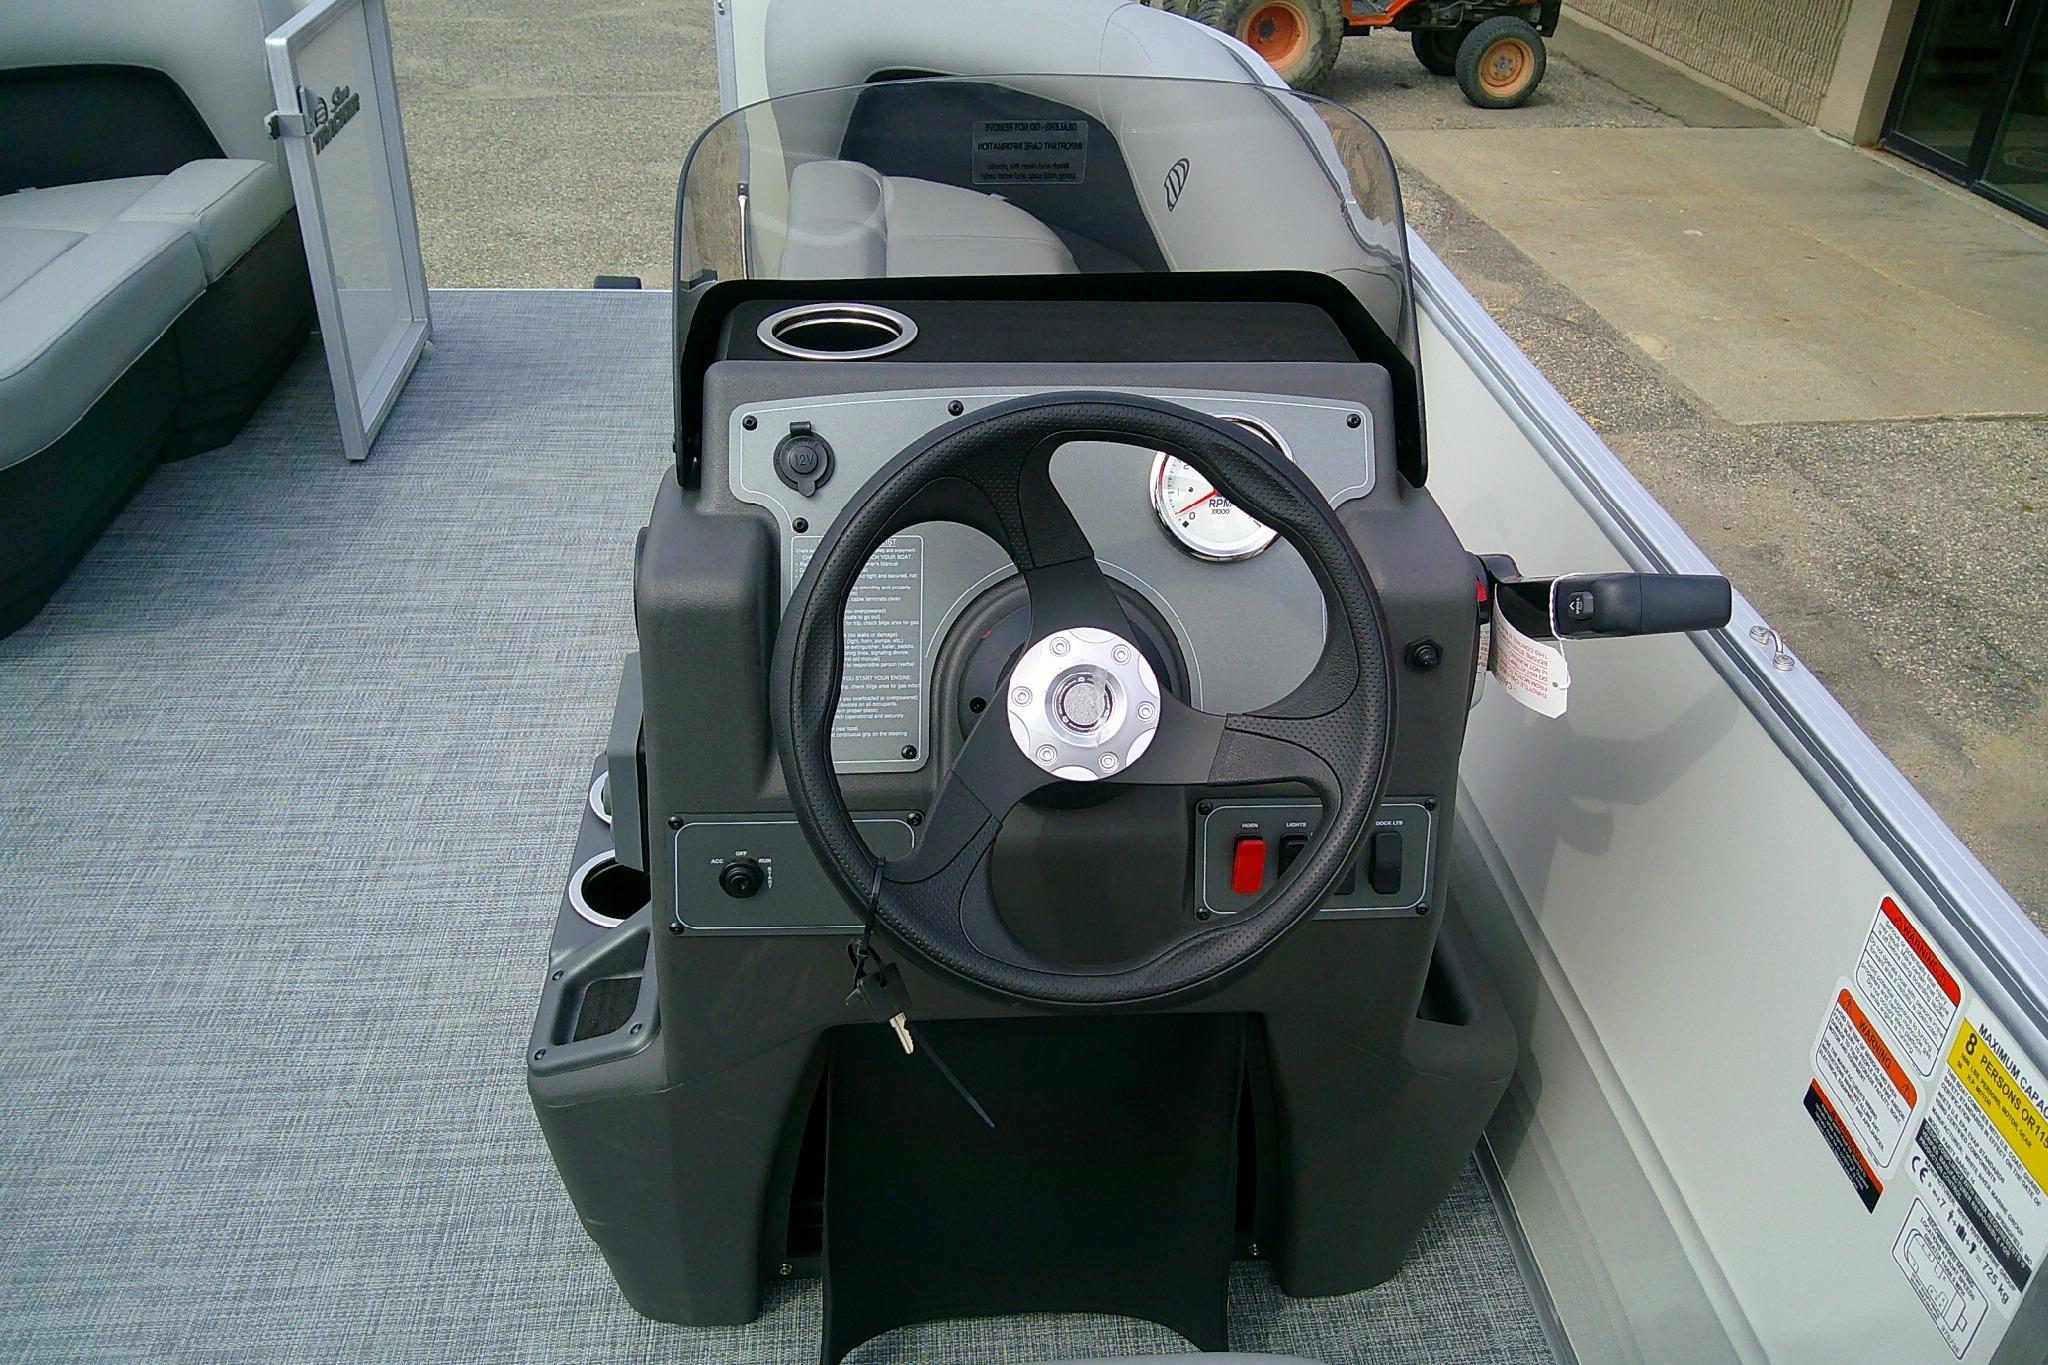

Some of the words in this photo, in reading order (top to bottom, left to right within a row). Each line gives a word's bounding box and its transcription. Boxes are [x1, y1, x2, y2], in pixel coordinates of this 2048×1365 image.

[795, 454, 814, 467] 12V
[1188, 511, 1196, 520] 0
[1903, 926, 1937, 972] WARNING
[1859, 1020, 1890, 1068] WARNING
[1979, 1024, 2019, 1078] MAXIMUM
[1941, 1082, 1970, 1122] CERTIFICATION
[1965, 1032, 1977, 1055] 8
[1980, 1055, 2020, 1109] PERSONS
[2021, 1108, 2034, 1130] OR
[1975, 1085, 1991, 1106] MOTOR
[1937, 1091, 1951, 1109] MEETS
[1950, 1108, 1958, 1121] U.S.
[1958, 1119, 1967, 1133] EPA
[1967, 1131, 1979, 1147] EVAP
[1979, 1147, 2004, 1182] STANDARDS
[1941, 1137, 1955, 1156] PARTY
[1943, 1075, 1959, 1095] SAFETY
[1959, 1095, 1983, 1130] STANDARDS
[1983, 1129, 1989, 1137] IN
[1988, 1135, 2005, 1158] EFFECT
[2005, 1158, 2012, 1169] ON
[2012, 1167, 2022, 1181] THE
[2021, 1179, 2033, 1198] DATE
[2033, 1196, 2041, 1206] OF
[1946, 1068, 1956, 1082] THIS
[1955, 1080, 1967, 1096] BOAT
[1967, 1096, 1988, 1125] COMPLIES
[1988, 1124, 2000, 1140] WITH
[1999, 1138, 2007, 1153] U.S.
[2008, 1151, 2023, 1172] COAST
[2023, 1172, 2040, 1194] GUARD
[1946, 1114, 1967, 1143] CERTIFIED
[1967, 1142, 1995, 1182] COMPONENTS
[2018, 1129, 2031, 1148] GEAR
[1939, 1197, 1945, 1207] 7
[1964, 1154, 1978, 1173] WHITE
[1977, 1172, 1991, 1191] RIVER
[1991, 1190, 2007, 1214] MARINE
[2007, 1214, 2023, 1235] GROUP
[1920, 1217, 1941, 1250] LOCATIONS
[1940, 1250, 1947, 1258] AT
[1946, 1258, 1958, 1274] BOAT
[1958, 1275, 1974, 1300] SPEEDS
[1924, 1233, 1941, 1260] GREATER
[1941, 1260, 1952, 1277] THAN
[1955, 1281, 1965, 1296] MPH
[1999, 1242, 2010, 1257] FOR
[2023, 1253, 2032, 1264] MO
[1982, 1261, 1998, 1284] 725
[1997, 1283, 2009, 1304] kg
